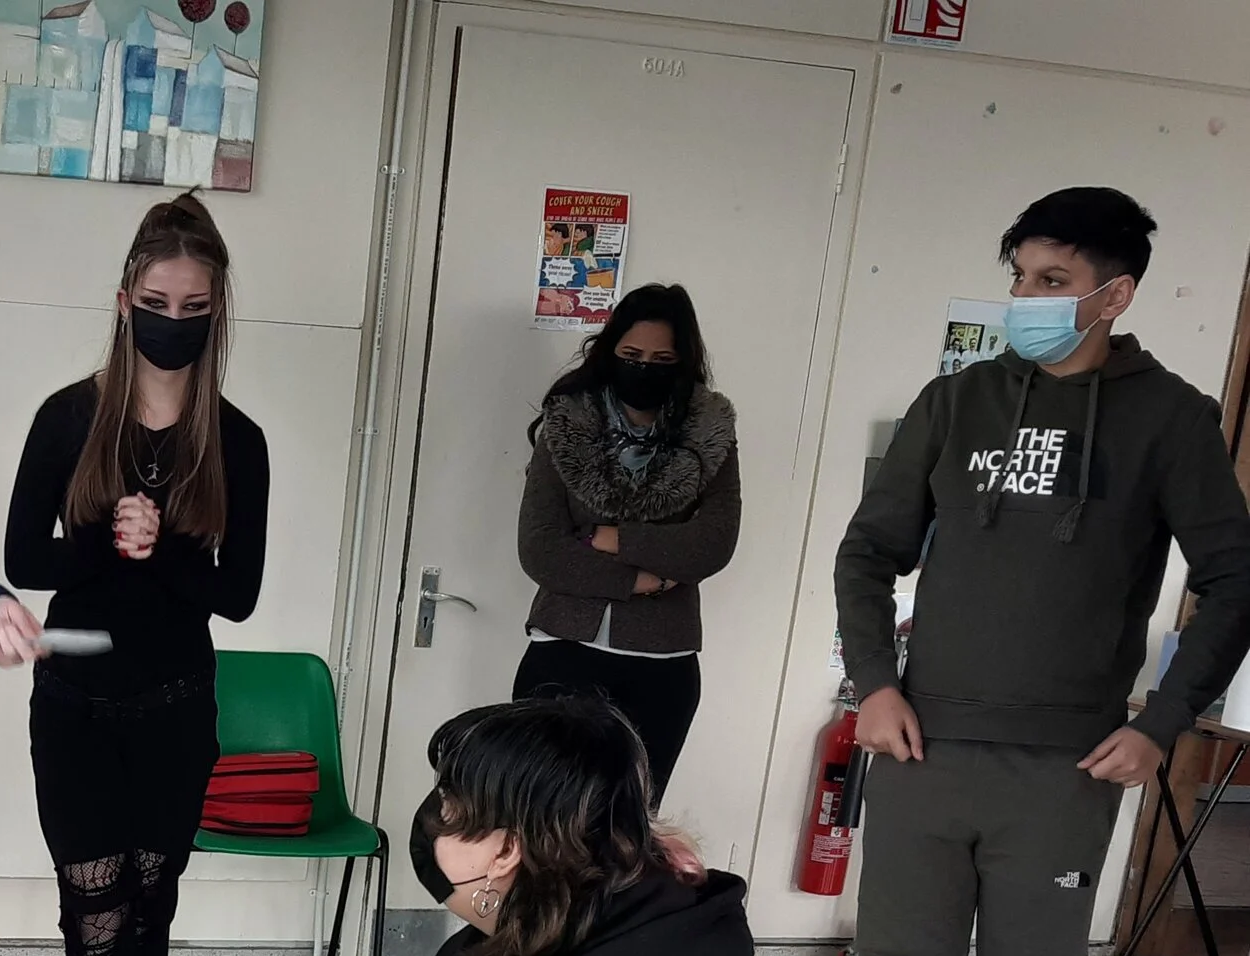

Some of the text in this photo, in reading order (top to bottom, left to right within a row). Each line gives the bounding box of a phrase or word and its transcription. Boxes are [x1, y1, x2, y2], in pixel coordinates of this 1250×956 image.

[643, 56, 686, 78] 604A
[549, 195, 622, 207] COVER YOUR COUGH
[569, 206, 615, 216] AND SNEEZE
[1016, 427, 1067, 451] THE
